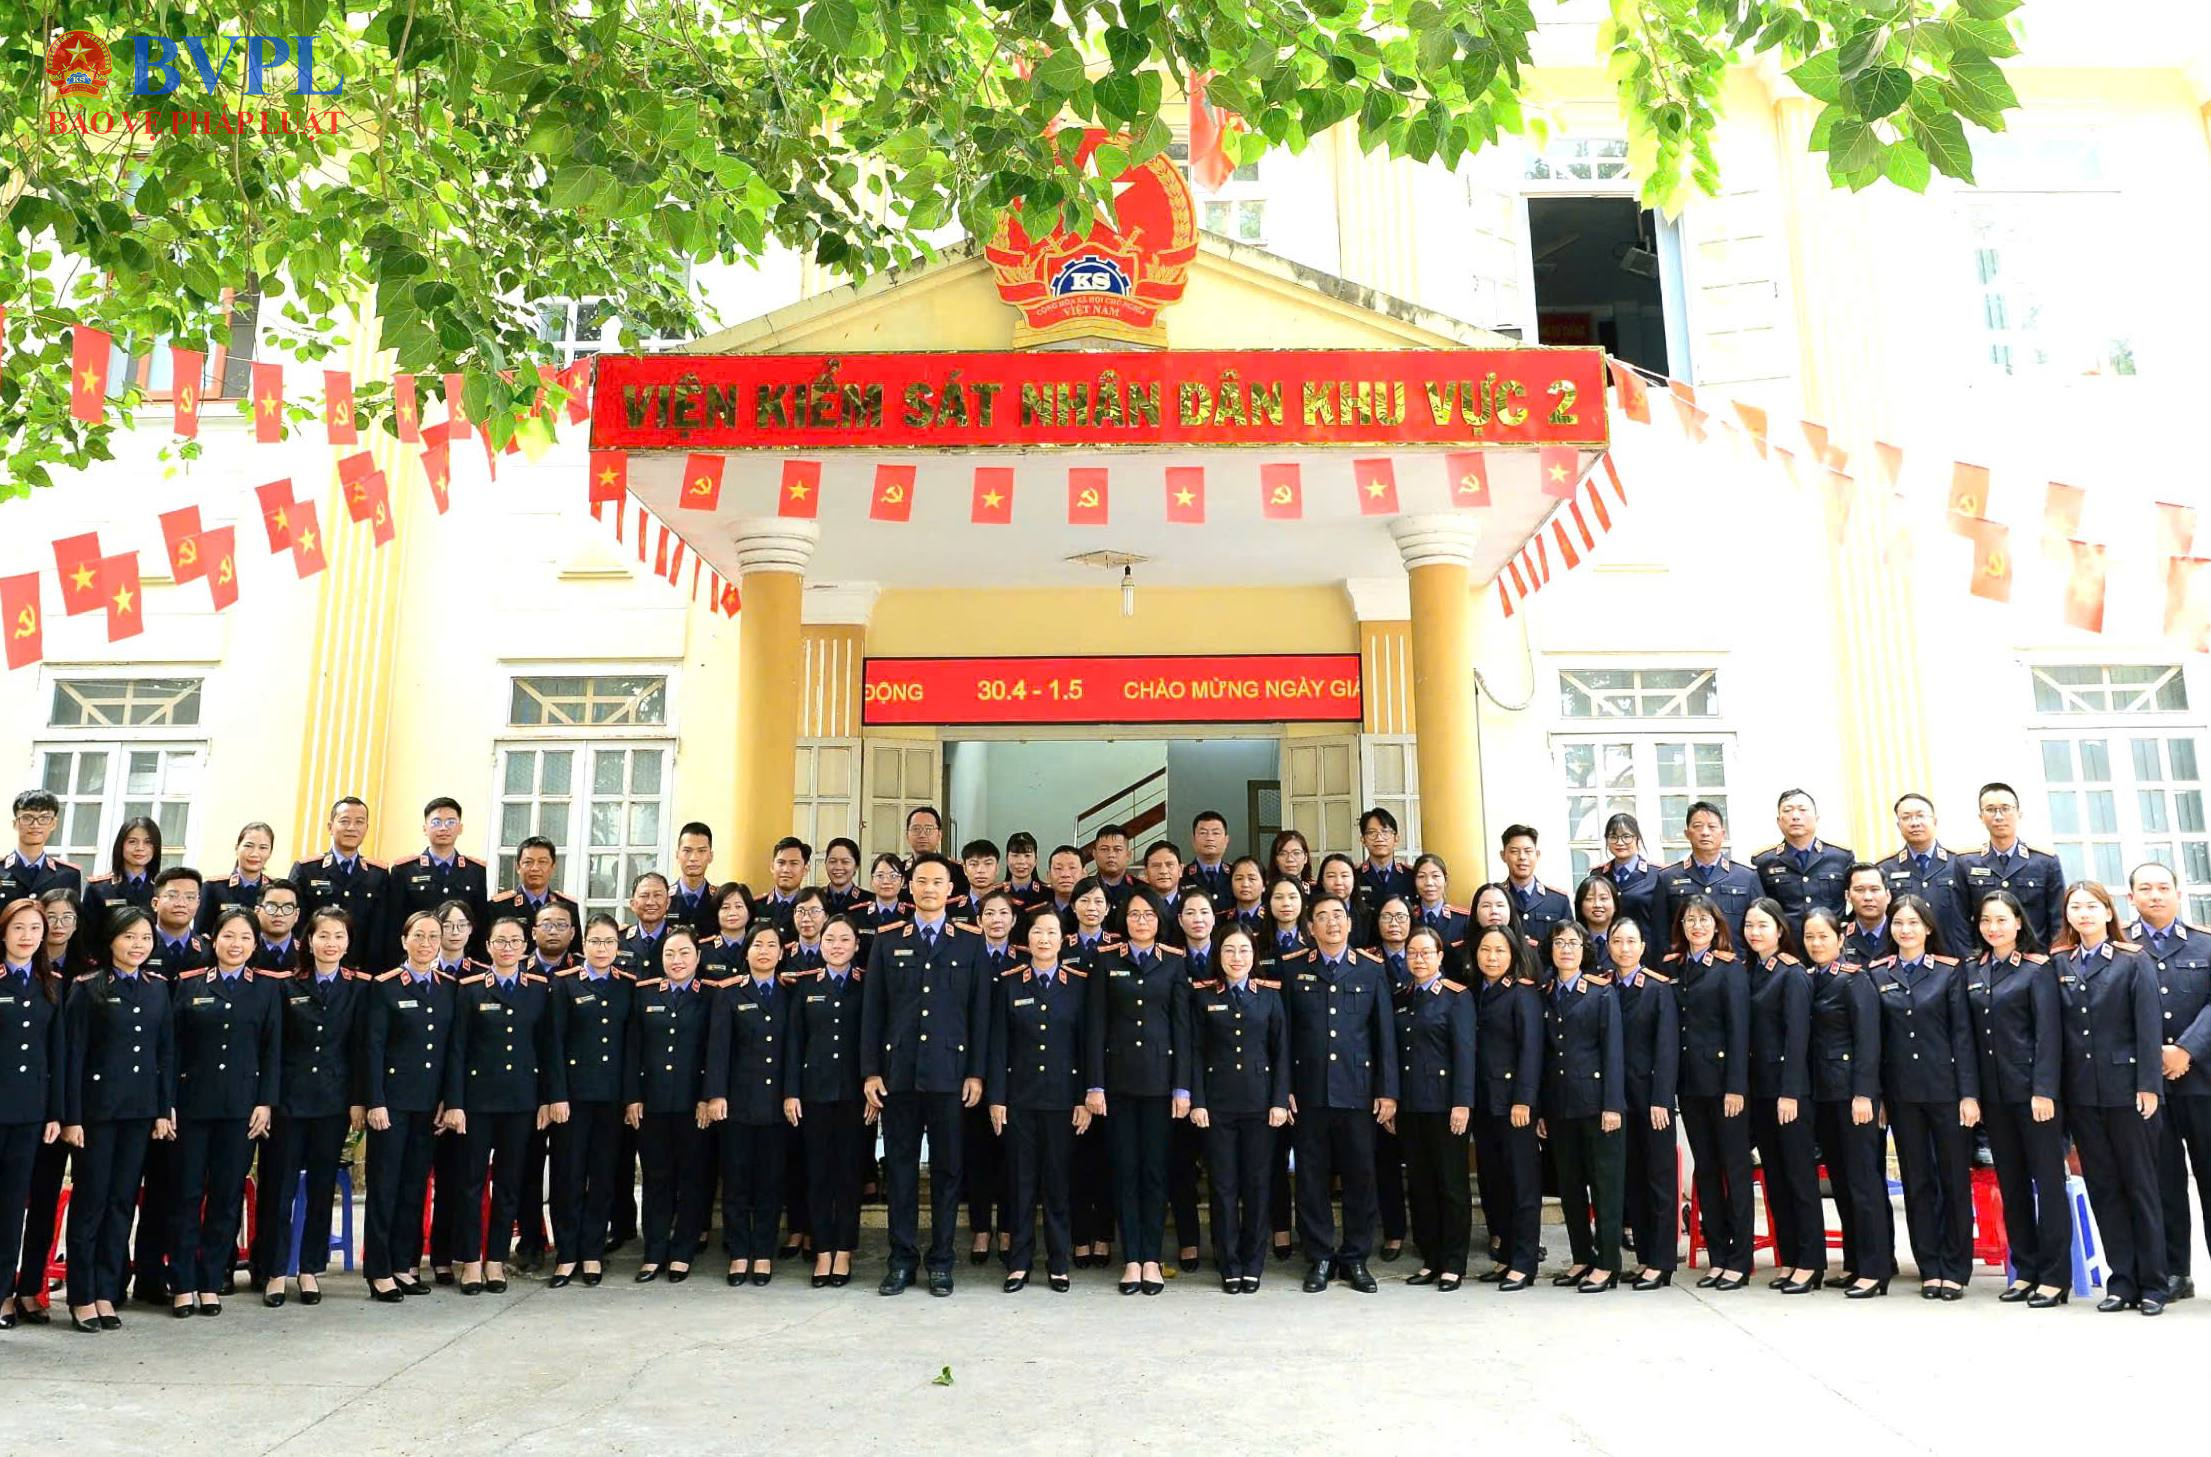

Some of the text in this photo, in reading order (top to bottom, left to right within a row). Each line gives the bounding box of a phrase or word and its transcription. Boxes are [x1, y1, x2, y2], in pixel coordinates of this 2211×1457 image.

[1070, 272, 1111, 291] KS
[1063, 304, 1120, 316] VIỆT NAM
[622, 358, 1579, 438] VIỆN KIỂM SÁT NHÂN DÂN KHU VỰC 2
[977, 679, 1026, 701] 30.4
[1049, 679, 1084, 701] 1.5
[1124, 677, 1186, 699] CHÀO
[1192, 676, 1259, 699] MỪNG
[1265, 676, 1325, 699] NGÀY
